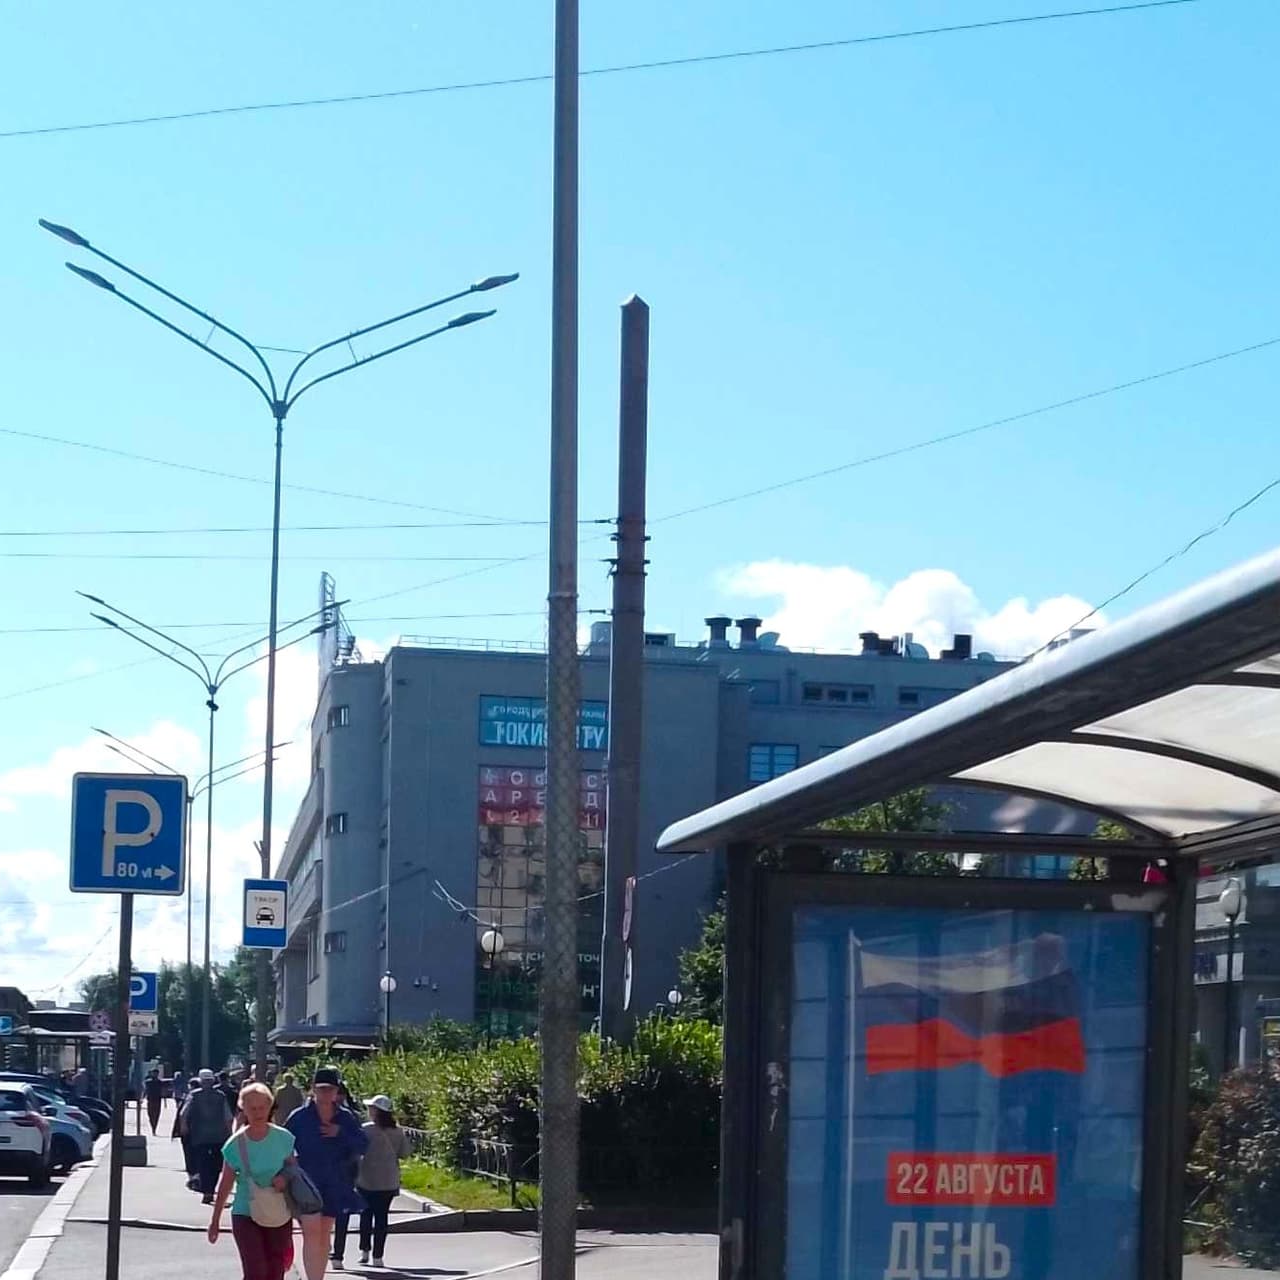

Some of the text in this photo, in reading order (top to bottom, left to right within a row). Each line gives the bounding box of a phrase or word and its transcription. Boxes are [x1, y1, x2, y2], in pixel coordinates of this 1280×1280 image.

[101, 789, 163, 877] P
[117, 862, 138, 878] 80
[896, 1162, 1045, 1195] 22 АВГУСТА
